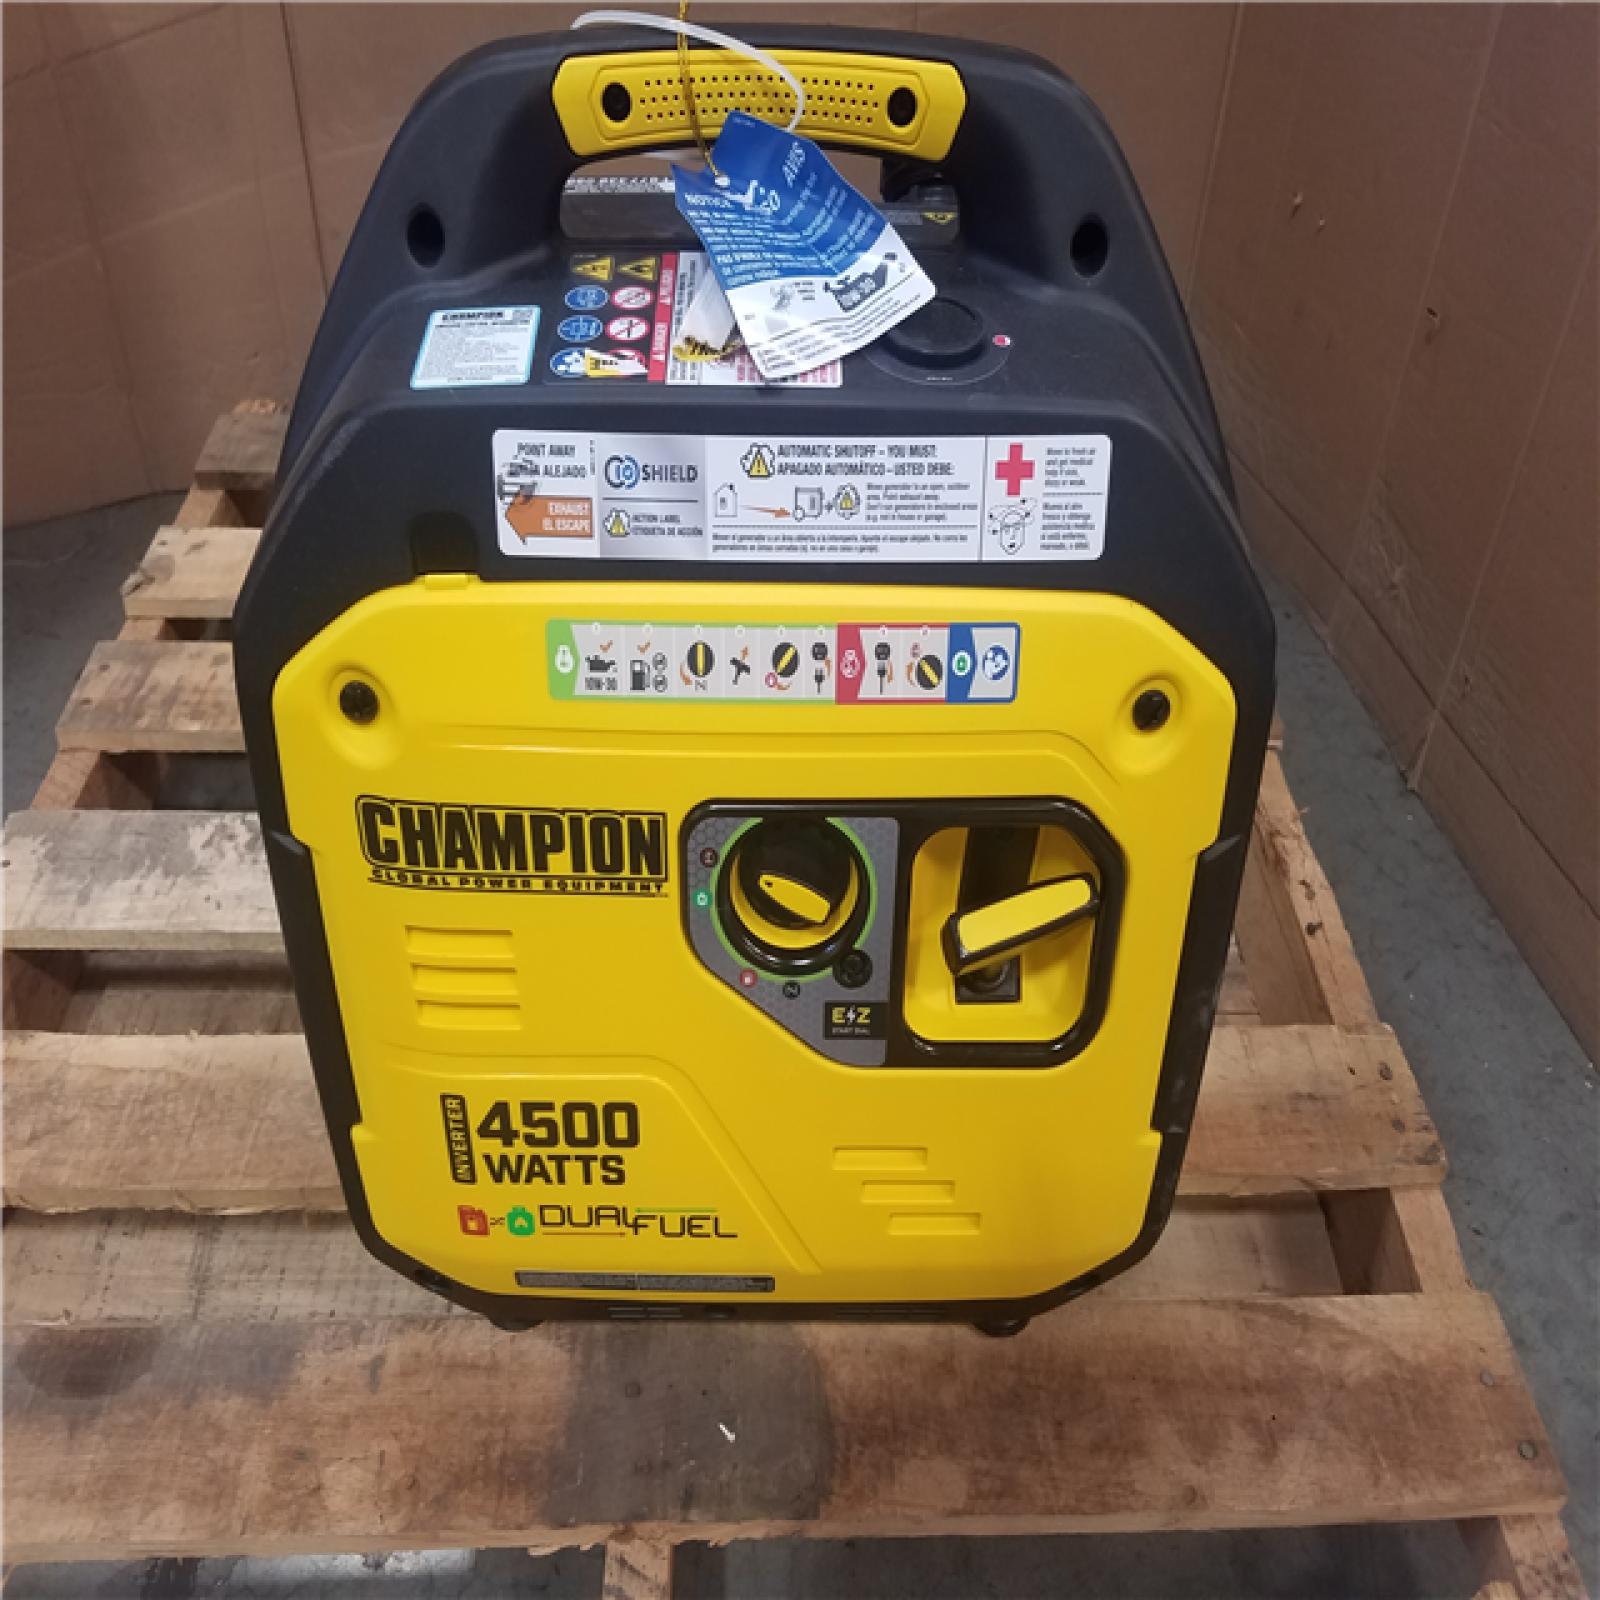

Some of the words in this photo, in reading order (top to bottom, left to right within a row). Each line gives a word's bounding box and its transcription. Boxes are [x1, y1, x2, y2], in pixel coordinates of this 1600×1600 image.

[517, 442, 546, 456] POINT
[777, 444, 833, 458] AUTOMATIC
[834, 444, 876, 458] SHUTOFF
[887, 445, 906, 458] YOU
[641, 464, 699, 482] SHIELD
[360, 800, 666, 878] CHAMPION
[369, 867, 450, 886] GLOBAL
[459, 876, 533, 889] POWER
[543, 880, 665, 893] EQUIPMENT
[443, 1096, 474, 1184] INVERTER
[475, 1100, 641, 1149] 4500
[482, 1154, 627, 1186] WATTS
[538, 1203, 635, 1229] DUAL
[624, 1213, 739, 1239] FUEL
